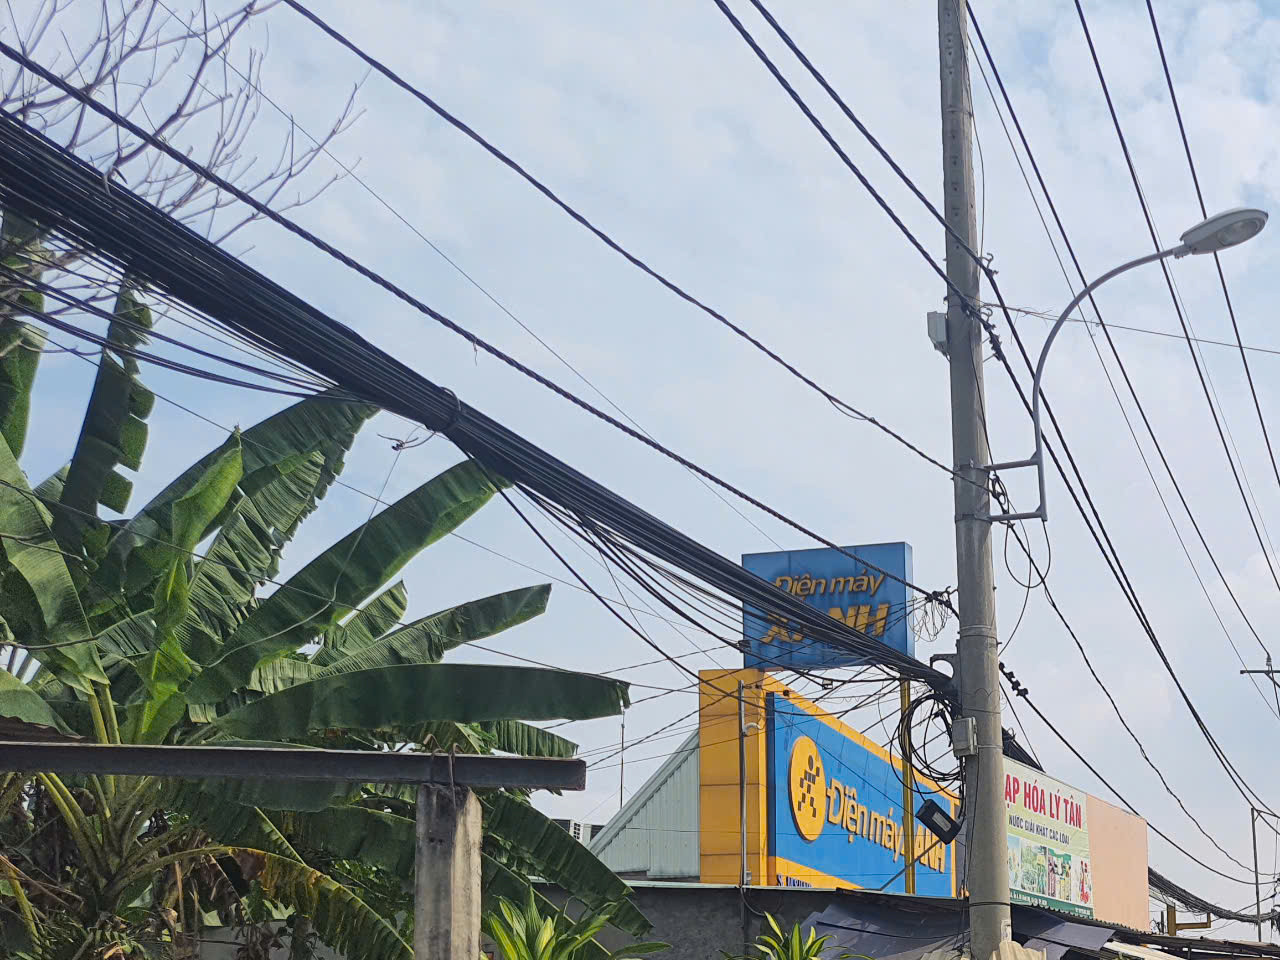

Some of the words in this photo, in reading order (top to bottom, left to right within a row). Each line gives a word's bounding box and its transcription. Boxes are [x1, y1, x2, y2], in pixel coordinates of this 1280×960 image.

[829, 568, 885, 596] máy
[826, 778, 868, 844] Điện
[868, 807, 904, 863] máy
[1005, 774, 1020, 808] ẠP
[1024, 779, 1046, 816] HÓA
[1049, 788, 1061, 821] LÝ
[1063, 794, 1082, 830] TÂN
